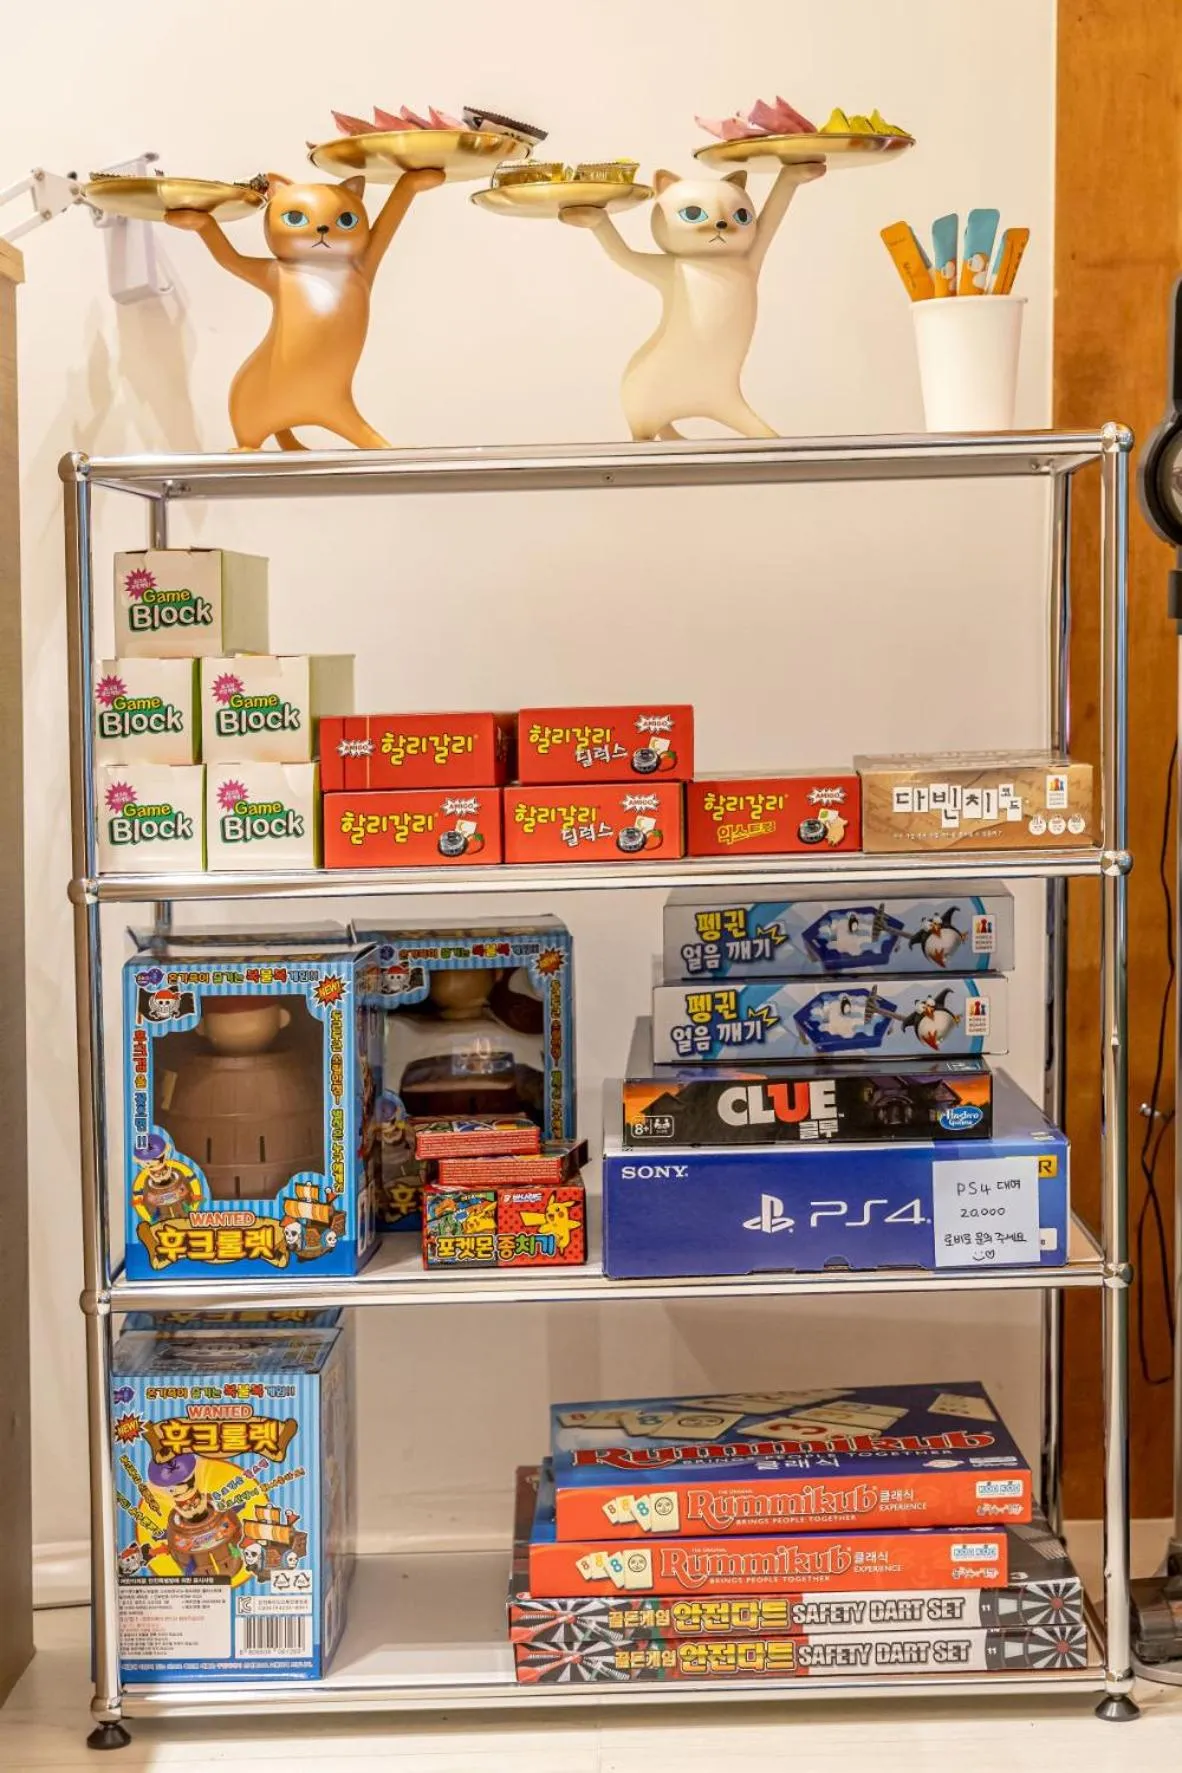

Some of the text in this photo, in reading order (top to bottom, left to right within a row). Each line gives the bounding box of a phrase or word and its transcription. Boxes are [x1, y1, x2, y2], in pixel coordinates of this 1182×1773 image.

[142, 587, 191, 604] Game
[130, 597, 212, 631] Block
[113, 696, 162, 711] Game
[230, 693, 280, 709] Game
[100, 704, 183, 739] Block
[217, 703, 300, 737] Block
[529, 723, 612, 754] 할리갈리
[381, 732, 473, 766] 할리갈리
[123, 803, 172, 818] Game
[234, 800, 283, 816] Game
[704, 792, 784, 821] 할리갈리
[221, 811, 304, 843] Block
[514, 803, 598, 833] 할리갈리
[110, 812, 193, 844] Block
[340, 810, 435, 845] 할리갈리
[717, 820, 776, 845] 익스트림
[695, 907, 748, 941] 펭귄
[681, 937, 774, 972] 얼음 깨기
[246, 968, 287, 984] 복불복
[318, 981, 340, 997] NEW!
[685, 990, 738, 1024] 펭귄
[671, 1020, 765, 1056] 얼음 깨기
[716, 1080, 839, 1127] CLUE
[634, 1123, 650, 1135] 8+
[799, 1120, 838, 1139] 클루
[621, 1165, 688, 1179] SONY
[956, 1181, 991, 1196] PS4
[189, 1212, 255, 1227] WANTED
[810, 1198, 925, 1228] PS4
[156, 1228, 276, 1261] 후크룰렛
[436, 1233, 556, 1261] 포켓몬 종치기
[944, 1233, 972, 1247] 로비로
[975, 1231, 992, 1246] 문의
[994, 1232, 1028, 1245] 주세요
[223, 1384, 264, 1398] 복불복
[189, 1405, 251, 1418] WANTED
[117, 1420, 139, 1434] NEW!
[161, 1421, 281, 1454] 후크룰렛
[572, 1431, 993, 1471] Rummikub
[756, 1456, 840, 1471] 클래식
[880, 1489, 914, 1503] 클래식
[637, 1502, 650, 1517] 8
[687, 1483, 877, 1531] Rummikub
[879, 1502, 928, 1512] EXPERIENCE
[736, 1517, 769, 1525] BRINGS
[809, 1514, 857, 1522] TOGETHER
[610, 1558, 623, 1573] 8
[660, 1544, 851, 1589] Rummikub
[854, 1551, 889, 1565] 클래식
[853, 1564, 904, 1573] EXPERIENCE
[709, 1577, 743, 1585] BRINGS
[782, 1575, 831, 1583] TOGETHER
[608, 1596, 966, 1632] 골든게임 안전다트 SAFETY DART SET
[981, 1604, 991, 1612] 11
[615, 1639, 972, 1673] 골든게임 안전다트 SAFETY DART SET
[987, 1647, 997, 1655] 11
